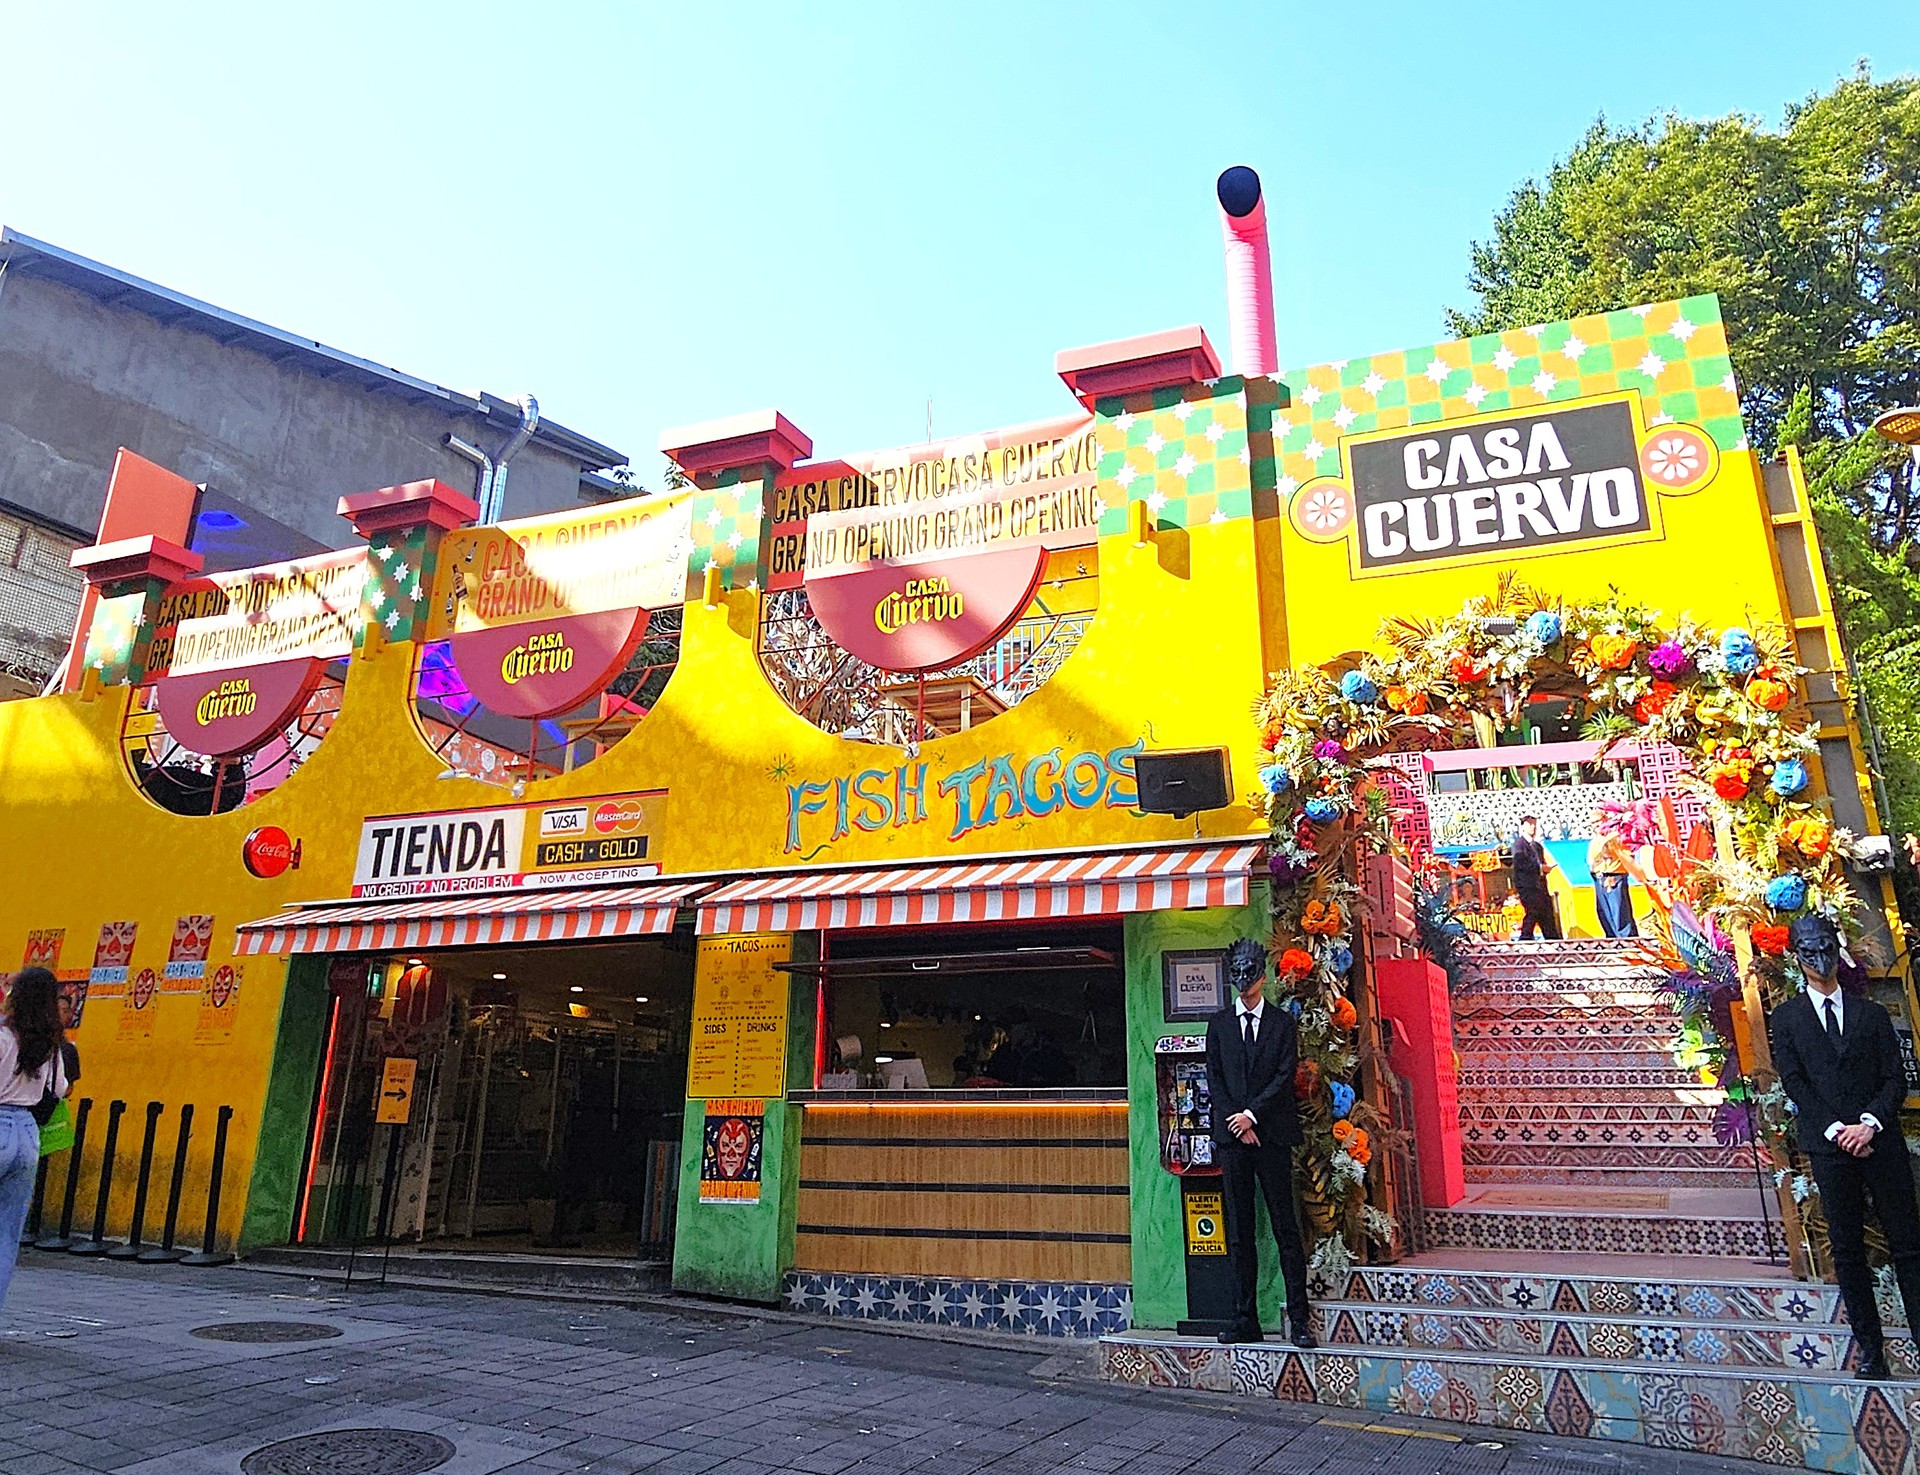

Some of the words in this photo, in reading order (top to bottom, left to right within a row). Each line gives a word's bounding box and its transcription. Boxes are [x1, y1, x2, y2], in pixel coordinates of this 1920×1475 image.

[1403, 421, 1572, 490] CASA
[773, 479, 831, 525] CASA
[1002, 432, 1098, 486] CUERVO
[1363, 466, 1640, 559] CUERVO
[772, 529, 837, 574] GRAND
[843, 513, 928, 565] OPENING
[934, 500, 1003, 550] GRAND
[476, 576, 548, 620] GRAND
[905, 576, 950, 597] CASA
[155, 592, 197, 629] CASA
[874, 591, 964, 635] Cuervo
[149, 634, 196, 671] GRAND
[528, 632, 564, 651] CASA
[501, 645, 574, 685] Cuervo
[220, 678, 250, 696] CASA
[196, 690, 257, 726] Cuervo
[784, 762, 928, 855] FISH
[938, 738, 1146, 843] TACOS
[551, 814, 578, 829] VISA
[371, 818, 506, 879] TIENDA
[545, 842, 584, 864] CASH
[599, 838, 638, 859] GOLD
[361, 885, 376, 898] NO
[378, 882, 427, 897] CREDIT?
[430, 878, 448, 893] NO
[451, 875, 513, 892] PROBLEM
[540, 874, 566, 884] NOW
[569, 868, 639, 883] ACCEPTING
[727, 939, 760, 953] TACOS
[1180, 983, 1212, 993] CUERVO
[1186, 975, 1206, 983] CASA
[704, 1023, 727, 1035] SIDES
[746, 1022, 777, 1033] DRINKS
[1188, 1195, 1219, 1203] ALERTA
[1191, 1244, 1223, 1252] POLICIA
